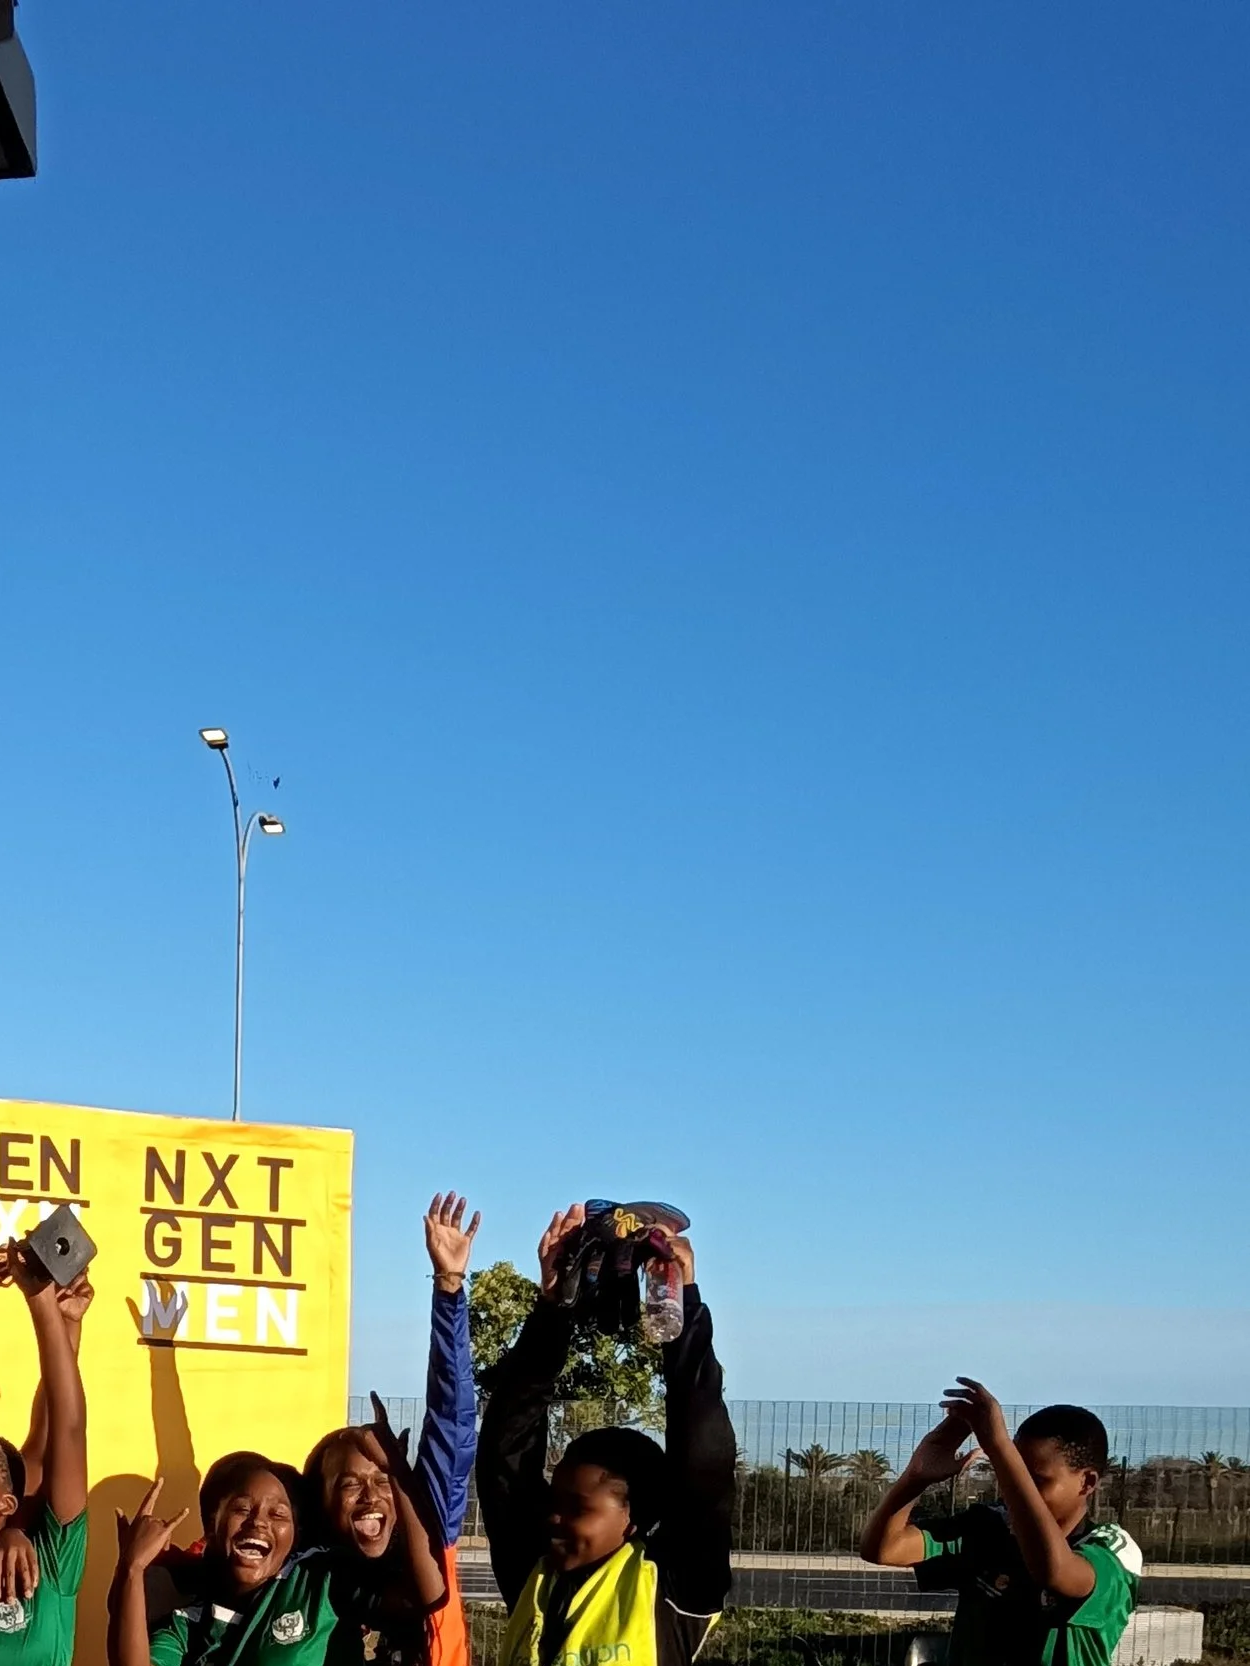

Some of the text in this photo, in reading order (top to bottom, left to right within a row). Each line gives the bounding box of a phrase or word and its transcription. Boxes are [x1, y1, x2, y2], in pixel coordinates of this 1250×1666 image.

[145, 1146, 295, 1213] NXT
[143, 1213, 294, 1278] GEN
[142, 1281, 299, 1347] MEN
